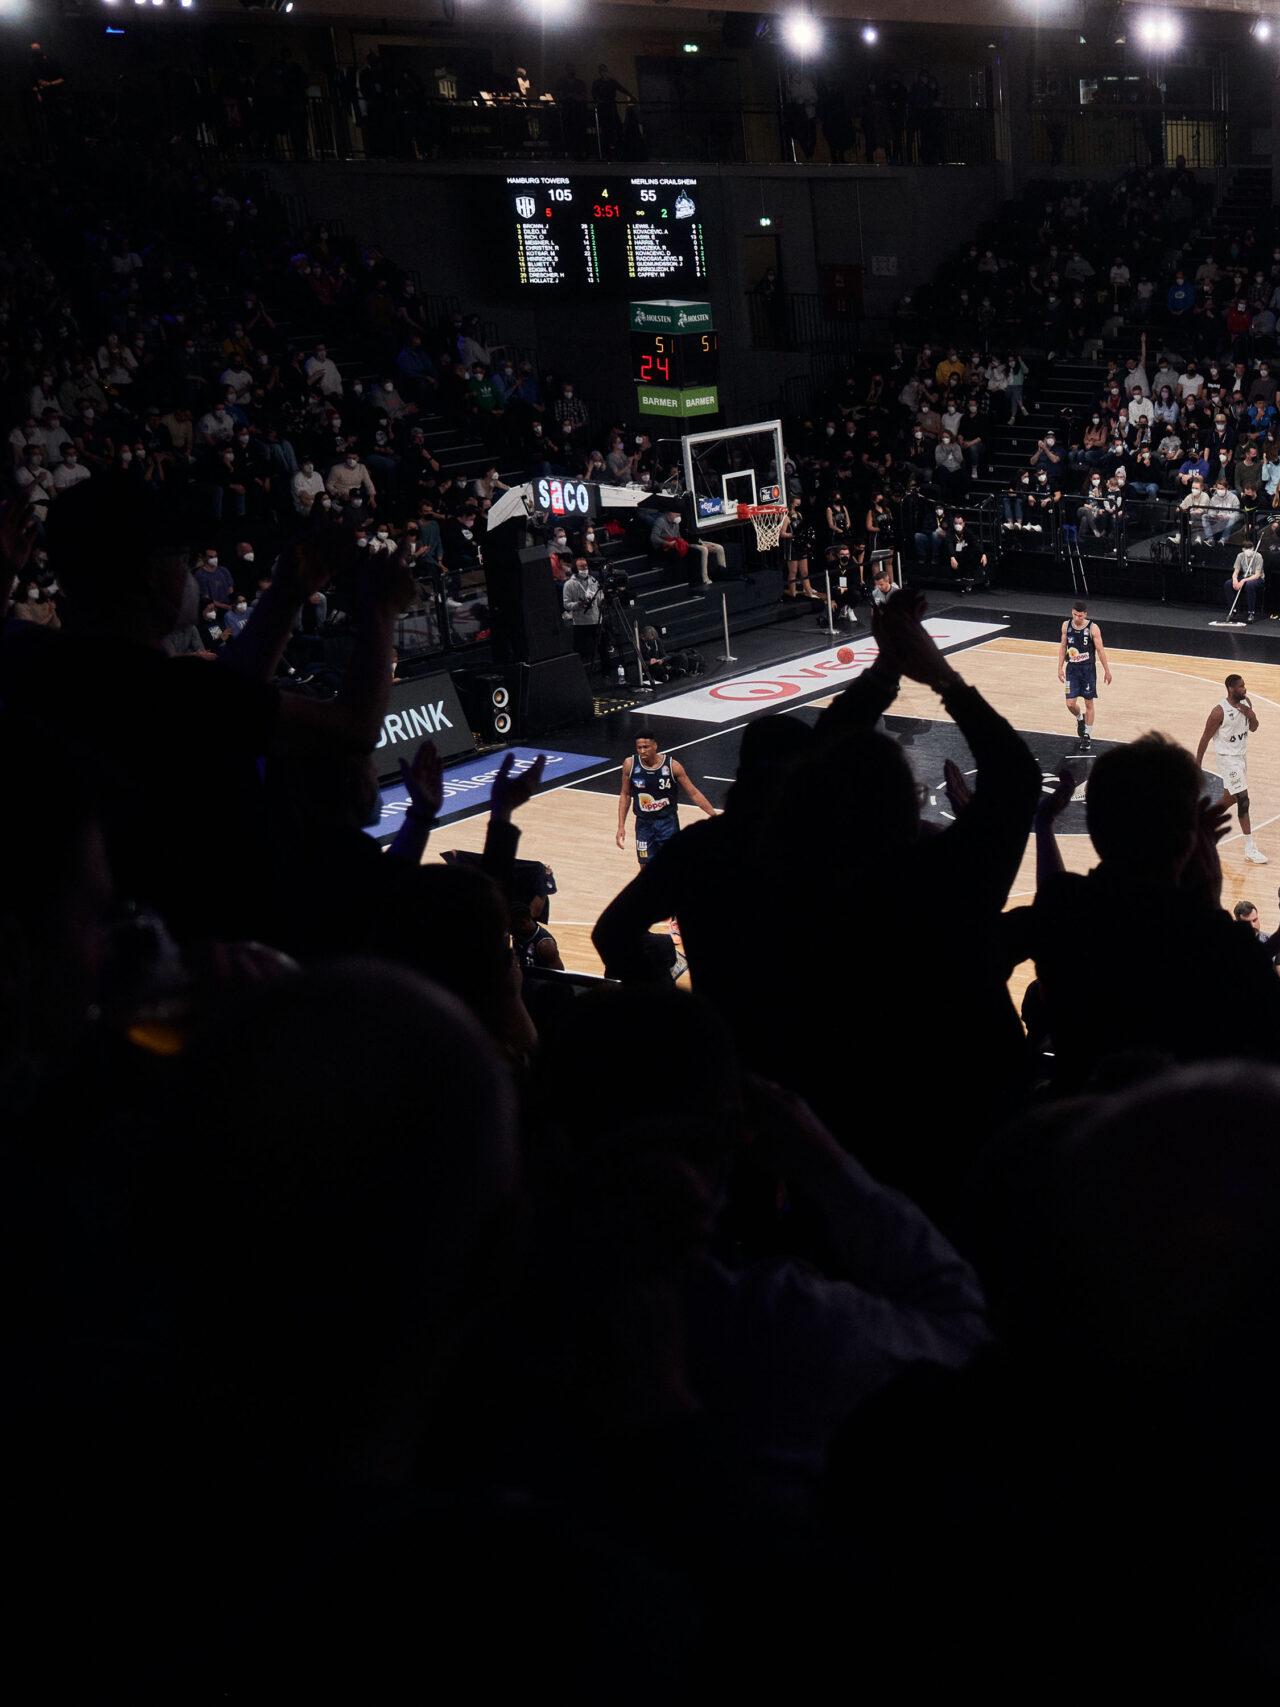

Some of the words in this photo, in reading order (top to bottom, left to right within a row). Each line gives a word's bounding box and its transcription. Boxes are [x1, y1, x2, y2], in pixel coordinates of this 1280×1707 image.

[548, 189, 572, 201] 105
[602, 188, 608, 198] 4
[640, 190, 656, 201] 55
[546, 208, 552, 217] 5
[593, 205, 619, 217] 3:51
[661, 209, 667, 218] 2
[641, 355, 669, 380] 24
[643, 396, 678, 407] BARMER
[686, 396, 715, 407] BARMER
[538, 480, 589, 513] saco
[1083, 637, 1088, 645] 5
[659, 779, 671, 790] 34
